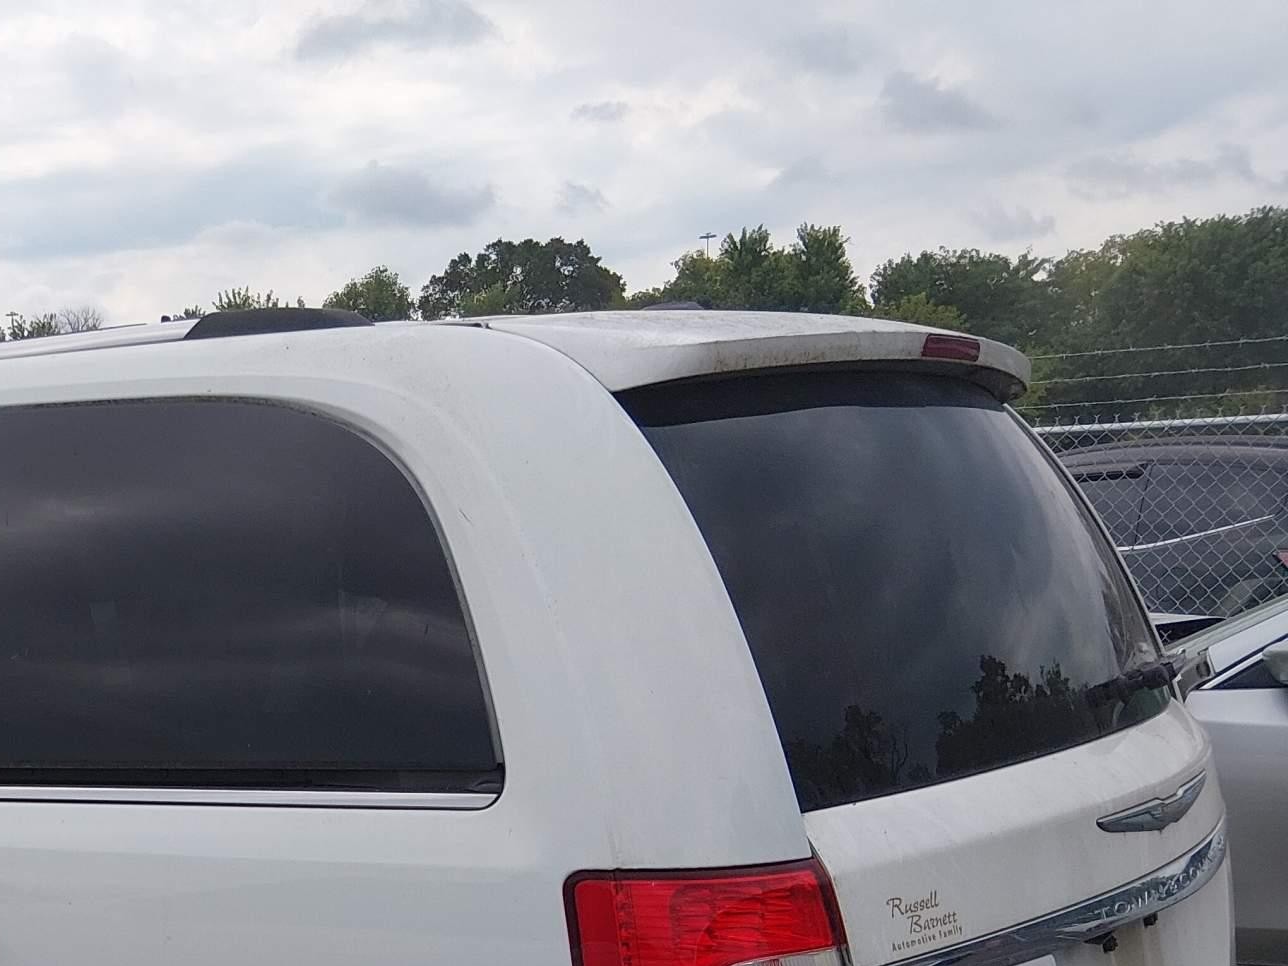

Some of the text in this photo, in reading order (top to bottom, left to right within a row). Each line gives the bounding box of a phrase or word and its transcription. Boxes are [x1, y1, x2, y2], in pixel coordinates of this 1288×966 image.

[886, 890, 939, 918] Russell
[907, 912, 957, 934] Barnett
[892, 935, 936, 952] Automotive
